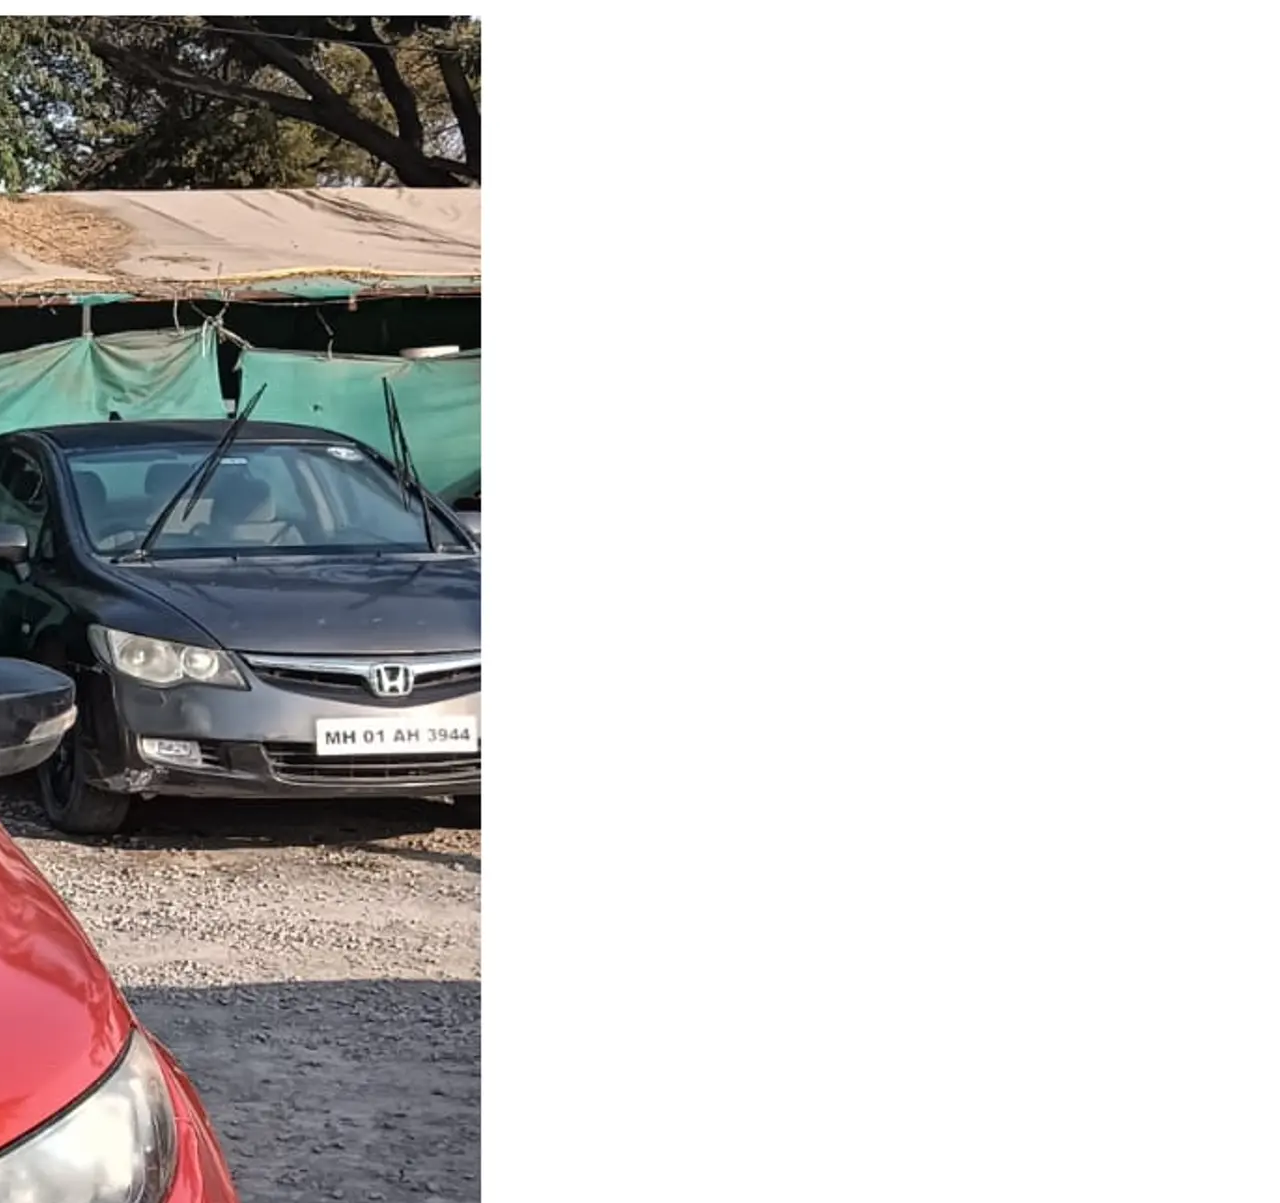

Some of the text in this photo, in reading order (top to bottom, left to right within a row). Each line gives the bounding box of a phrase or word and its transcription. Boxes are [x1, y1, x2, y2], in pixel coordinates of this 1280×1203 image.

[324, 727, 471, 745] MH 01 AH 3944
